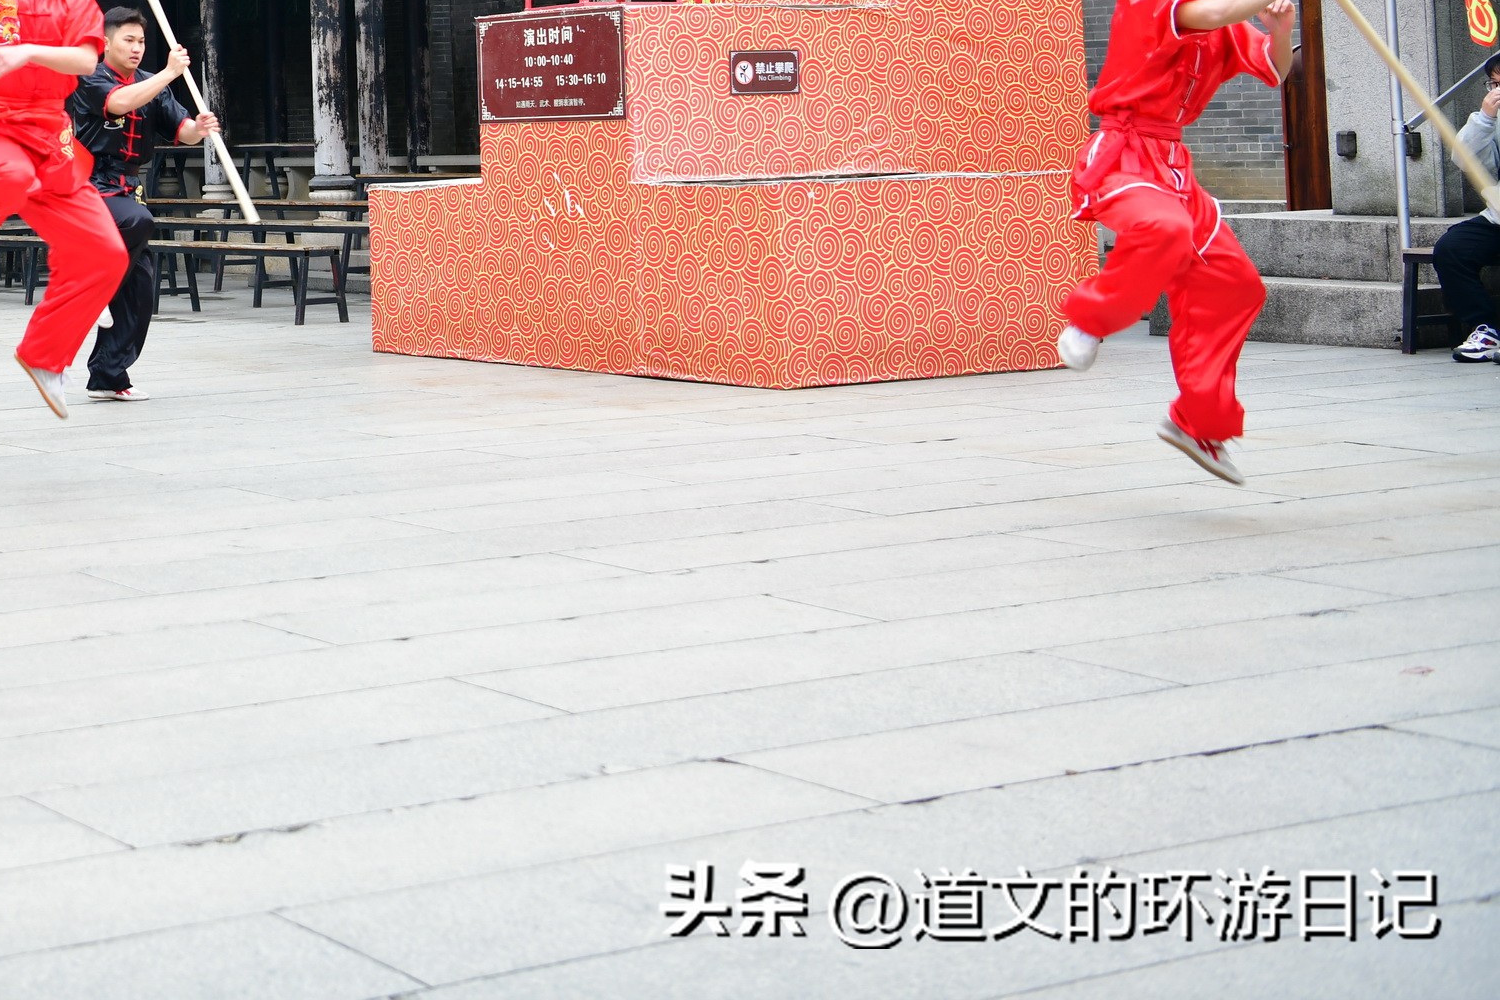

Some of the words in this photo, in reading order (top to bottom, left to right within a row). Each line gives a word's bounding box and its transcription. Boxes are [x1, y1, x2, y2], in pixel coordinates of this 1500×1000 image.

[523, 25, 573, 47] 演出时间
[524, 53, 573, 67] 10:00-10:40
[755, 61, 795, 75] 禁止攀爬
[495, 76, 543, 89] 14:15-14:55
[555, 72, 607, 86] 15:30-16:10
[767, 74, 792, 83] Climbing
